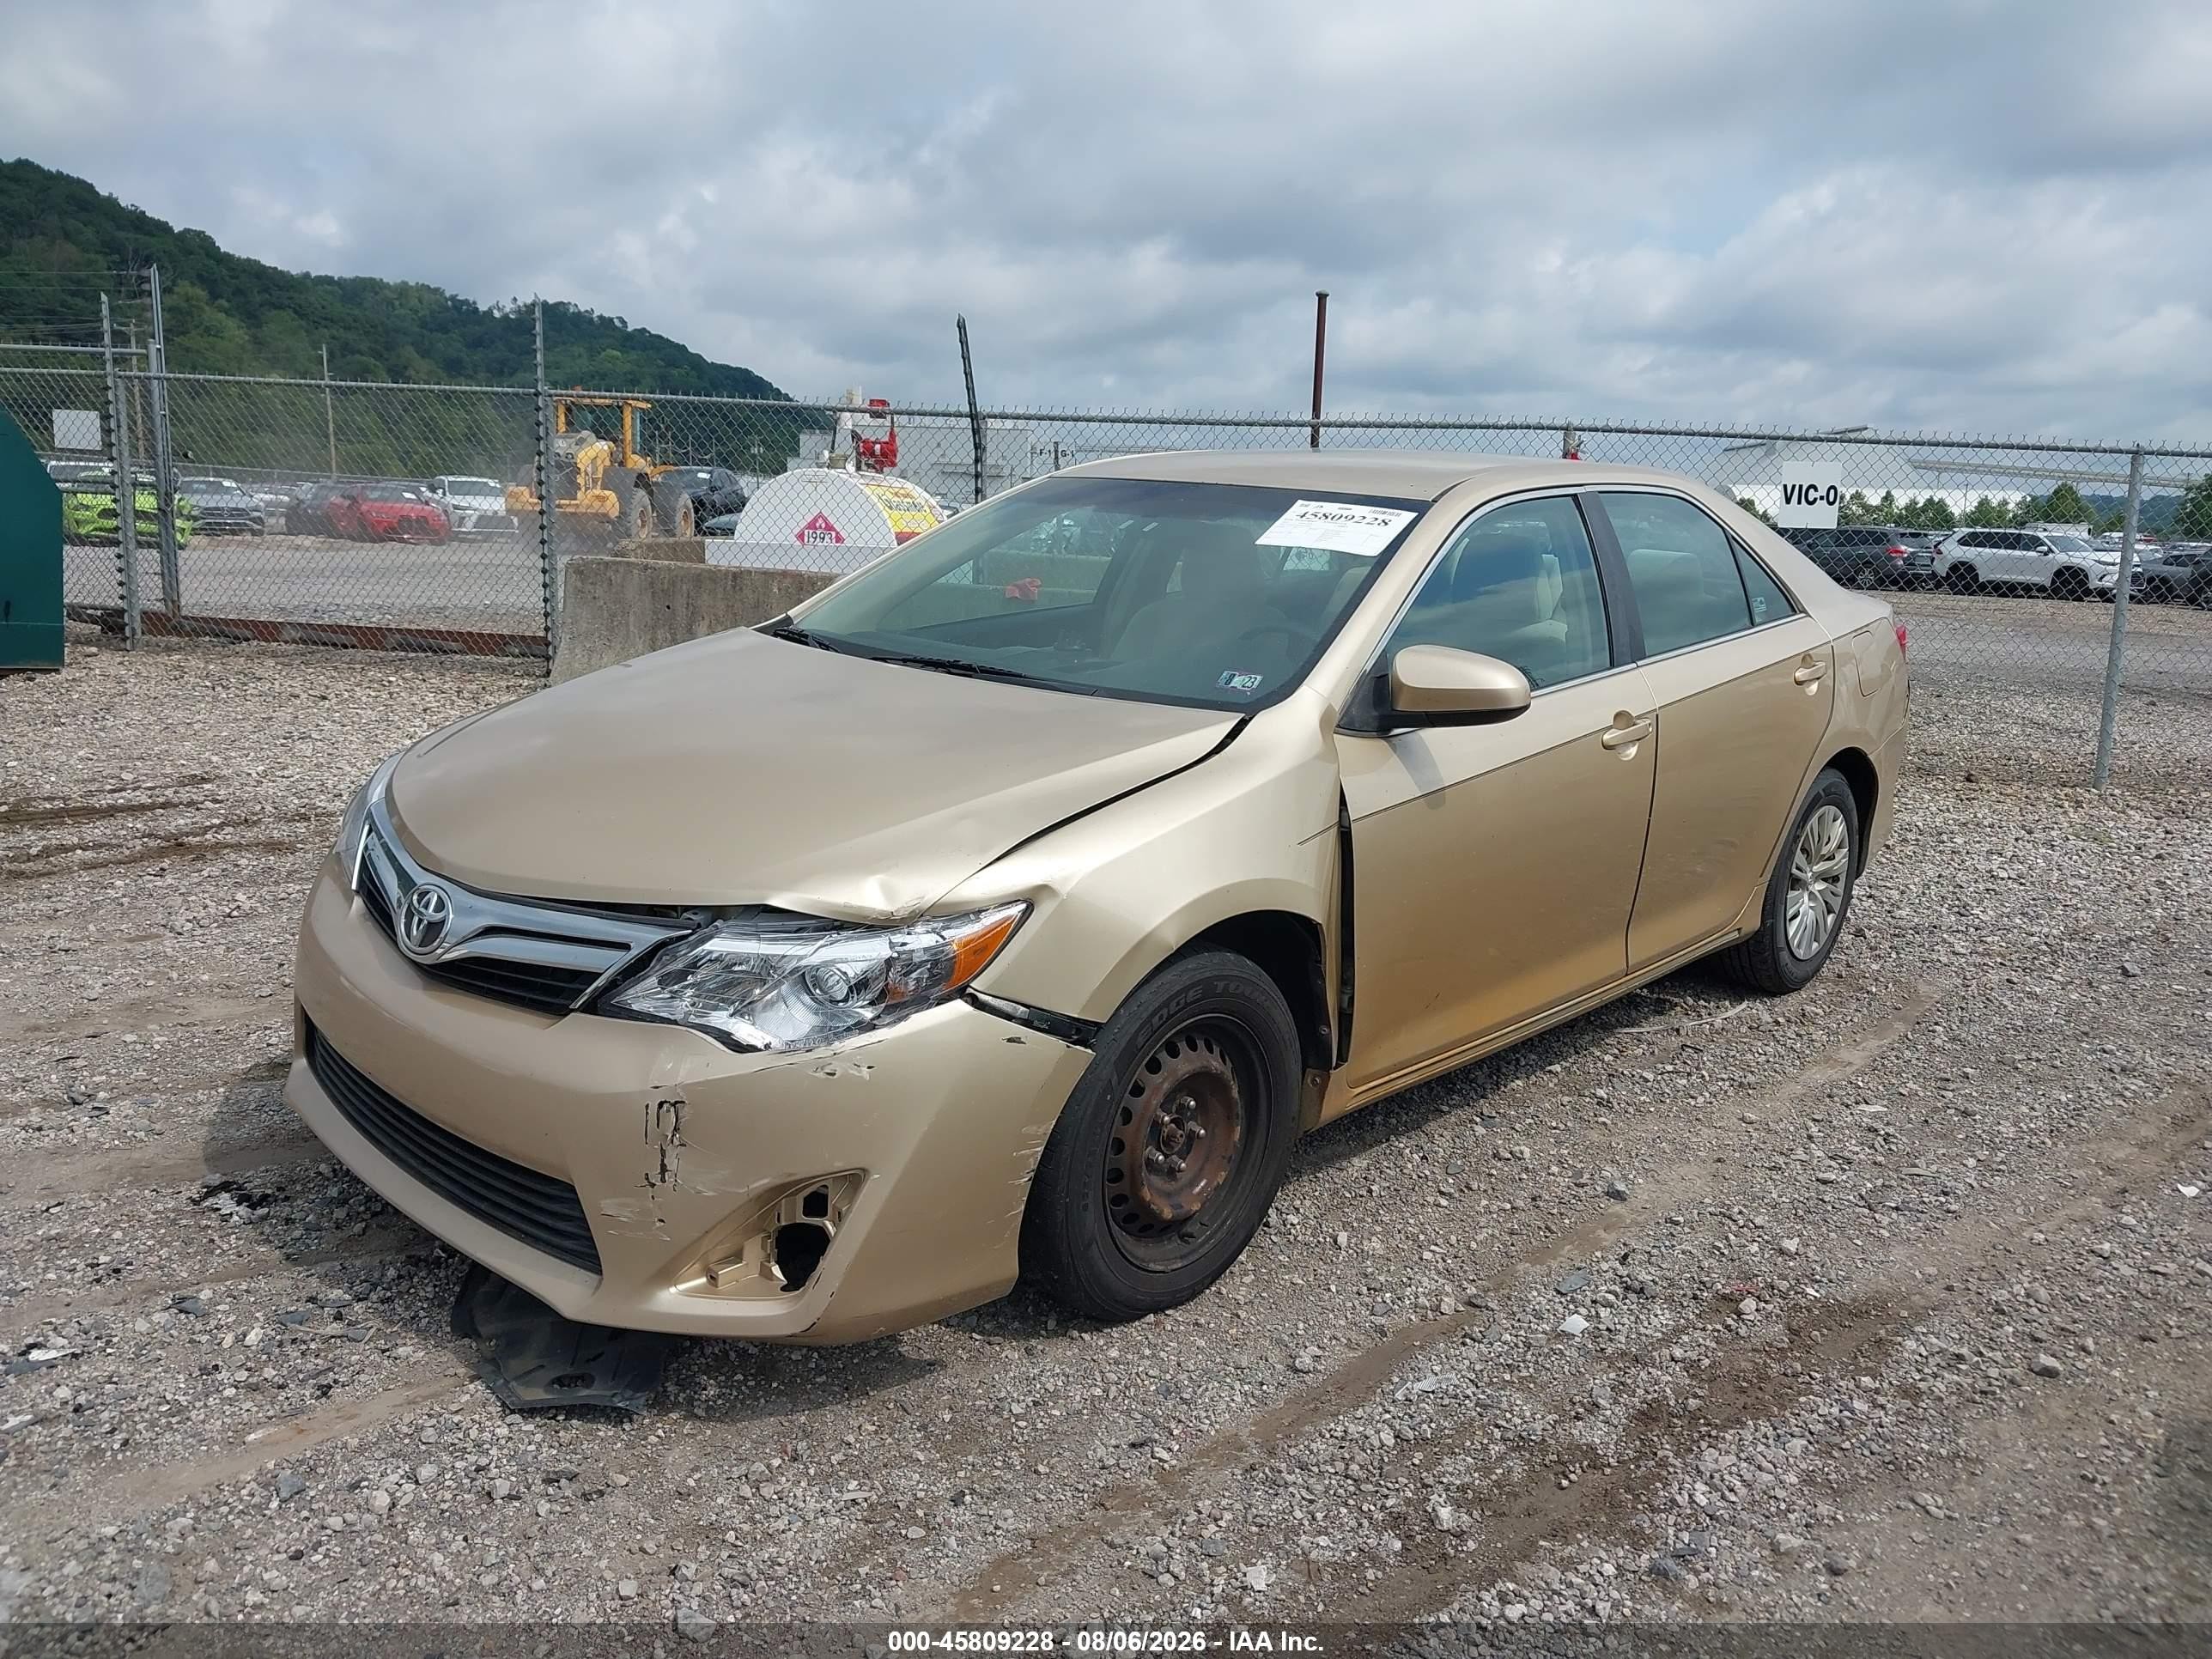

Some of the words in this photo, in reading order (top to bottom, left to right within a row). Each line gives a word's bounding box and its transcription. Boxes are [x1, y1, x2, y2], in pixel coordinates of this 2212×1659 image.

[1296, 510, 1393, 527] 45809228
[805, 530, 833, 544] 1993
[1241, 676, 1258, 689] 23
